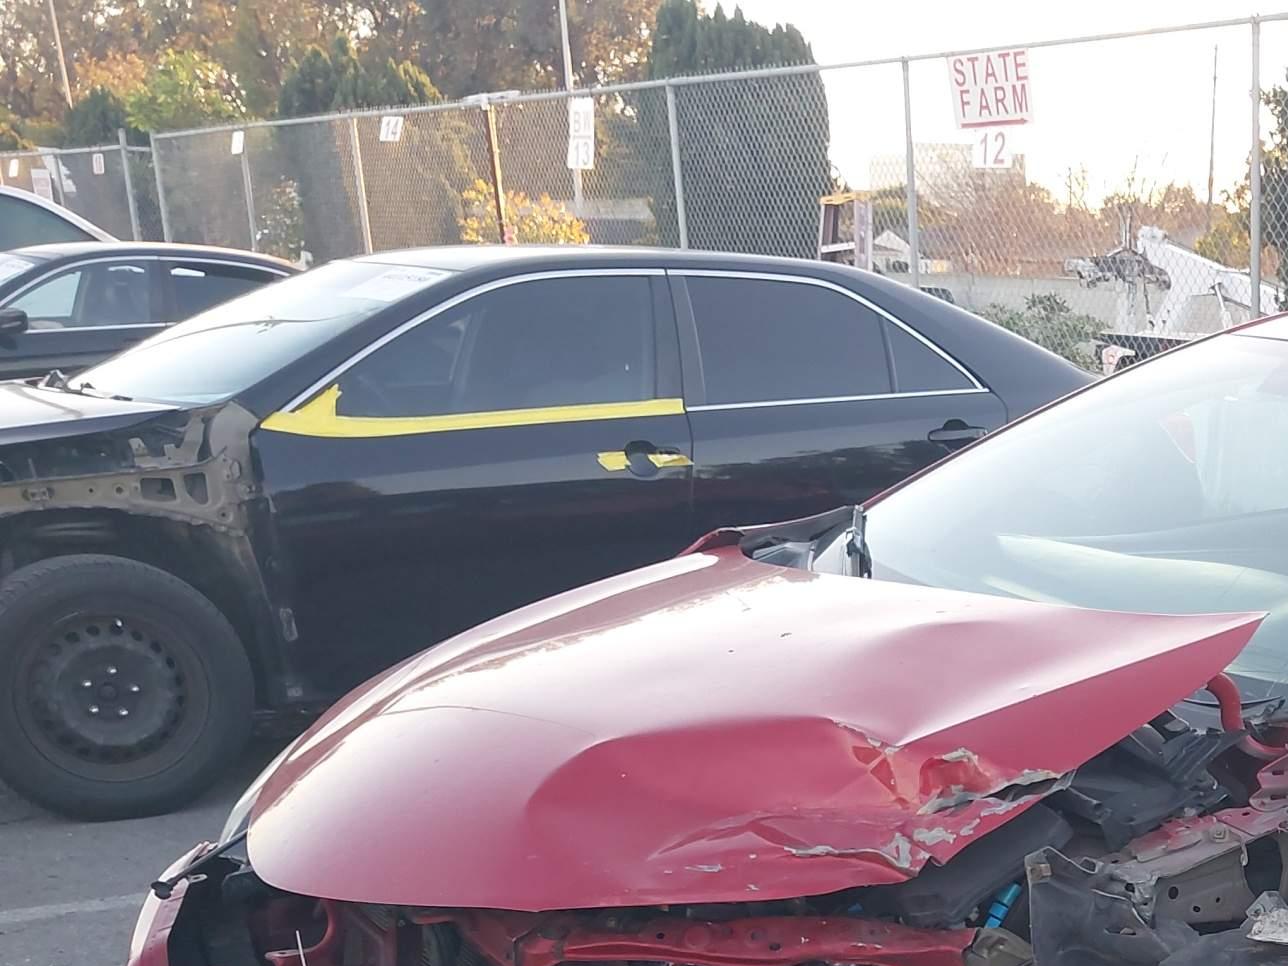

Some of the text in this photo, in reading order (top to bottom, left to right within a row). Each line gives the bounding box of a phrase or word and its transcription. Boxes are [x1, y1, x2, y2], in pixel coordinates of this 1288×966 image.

[952, 50, 1028, 88] STATE
[960, 83, 1029, 118] FARM
[384, 117, 399, 140] 14
[574, 141, 591, 166] 13
[980, 130, 1006, 165] 12
